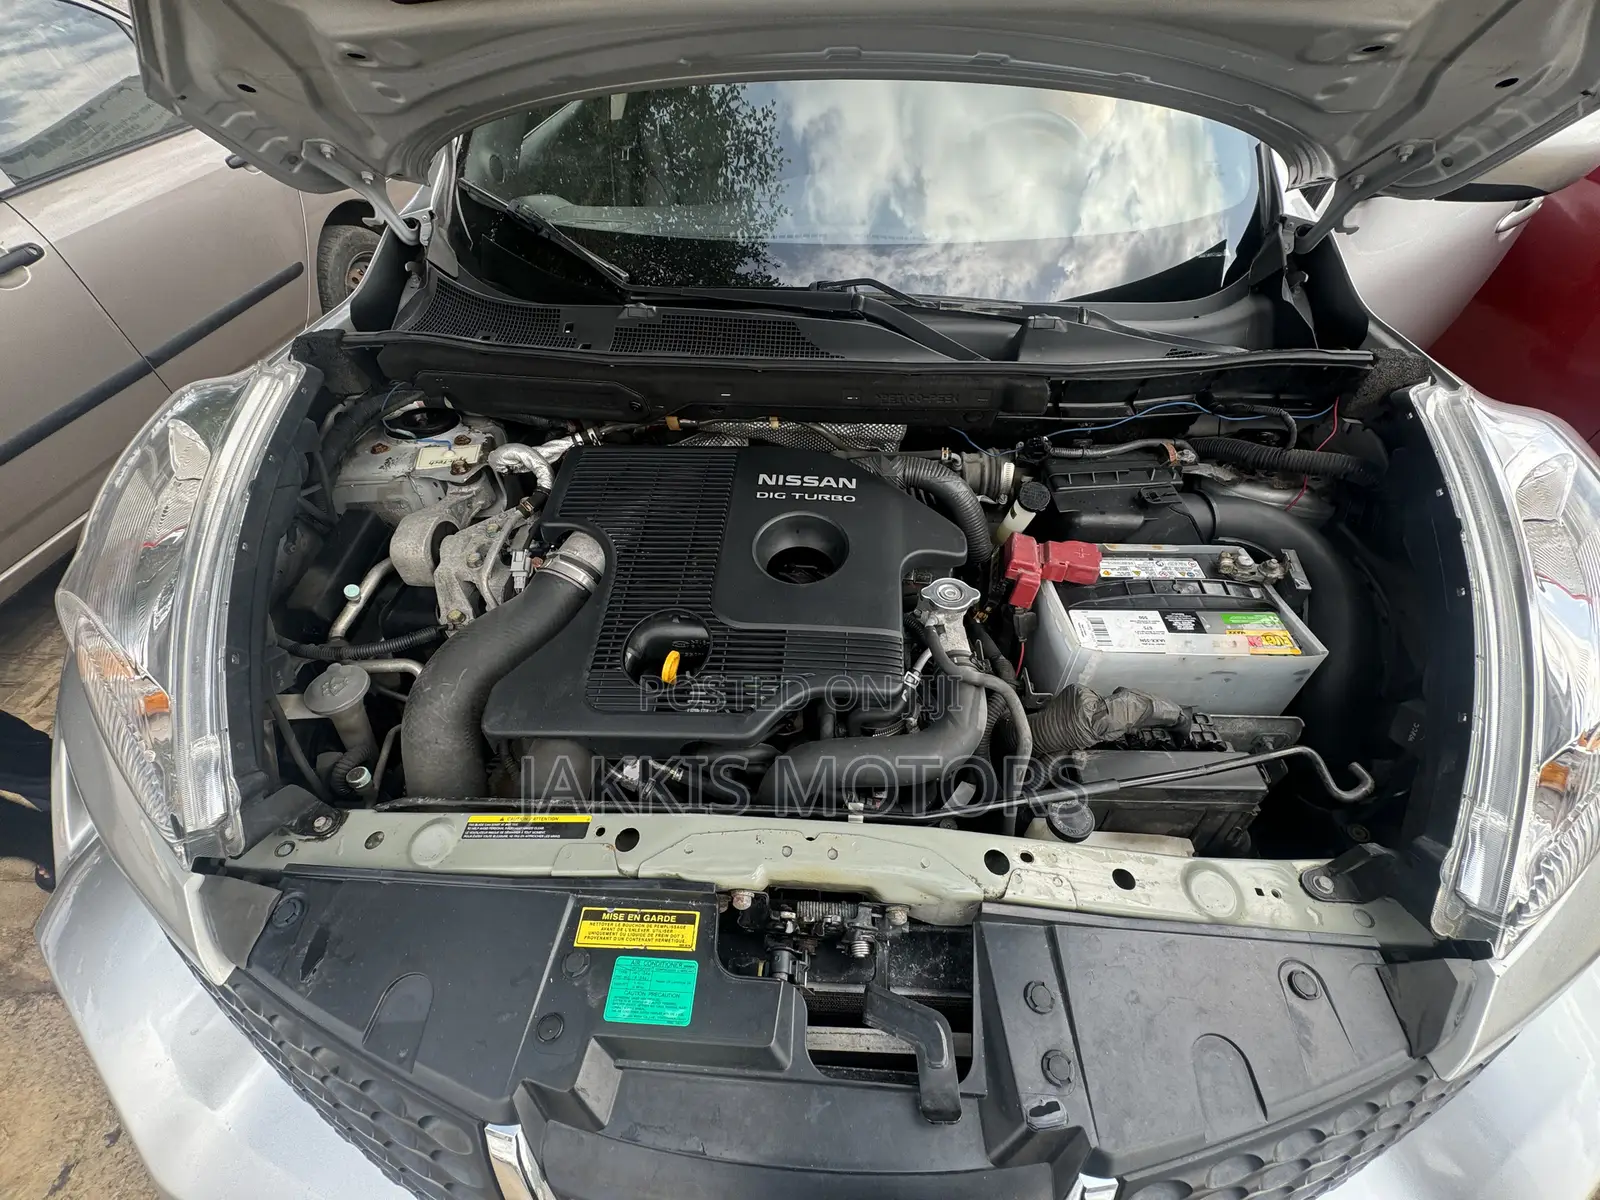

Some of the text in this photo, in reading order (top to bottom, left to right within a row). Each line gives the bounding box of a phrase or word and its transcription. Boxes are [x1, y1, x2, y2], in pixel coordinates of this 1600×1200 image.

[757, 473, 857, 489] NISSAN
[756, 491, 856, 502] DIG TURBO
[601, 912, 677, 923] MISE EN GARDE
[644, 960, 682, 968] CONDITIONER
[624, 989, 681, 999] CAUTION PRECAUTION
